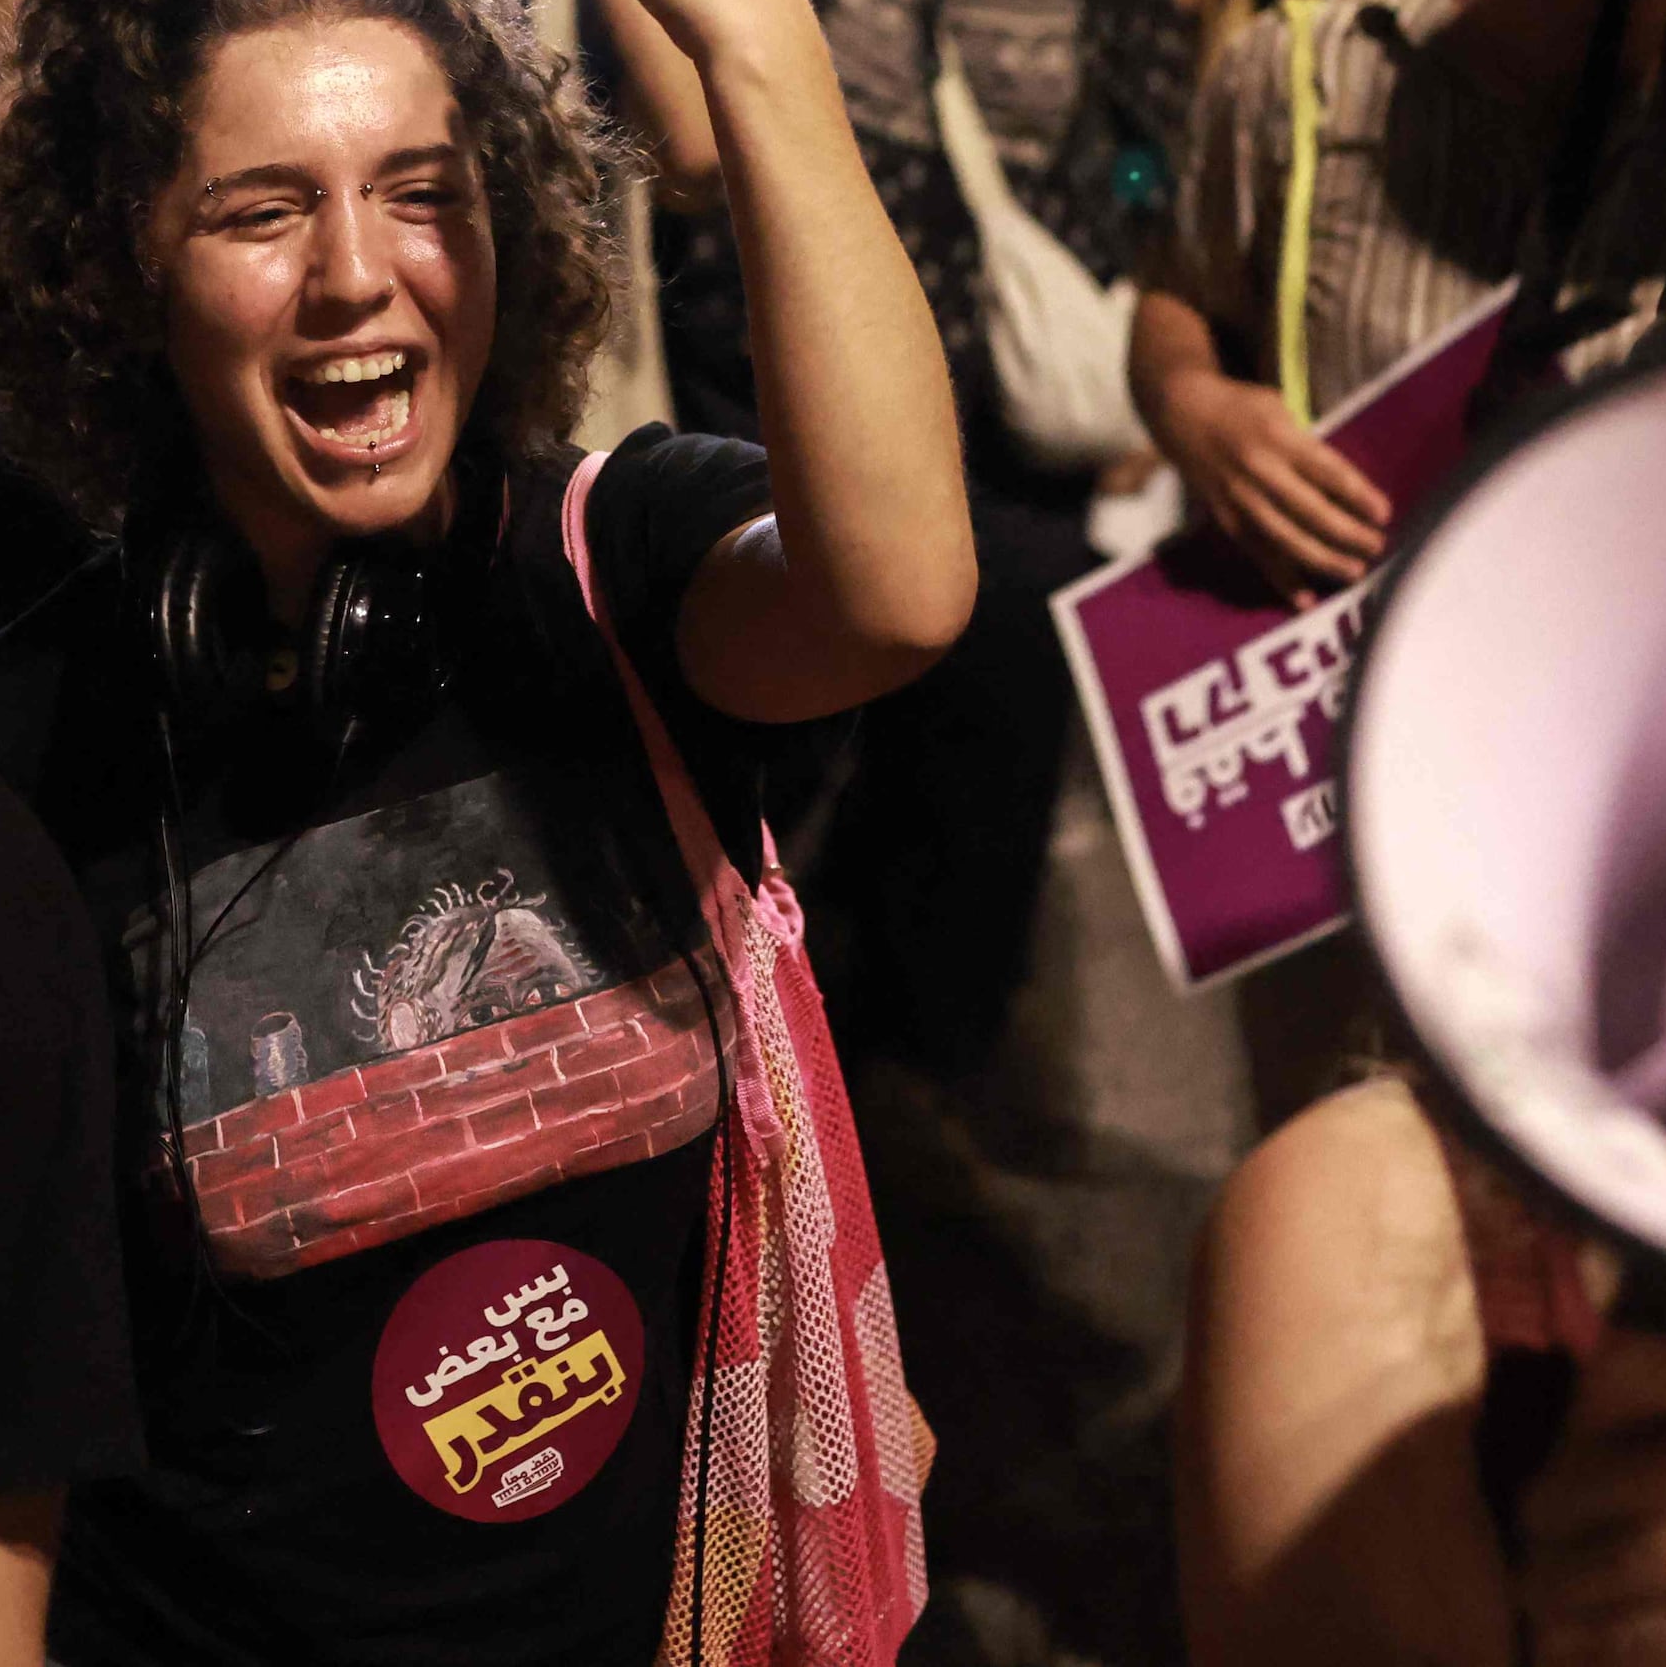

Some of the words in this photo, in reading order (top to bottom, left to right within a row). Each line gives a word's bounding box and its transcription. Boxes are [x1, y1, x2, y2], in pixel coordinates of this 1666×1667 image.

[483, 1264, 572, 1328] بس
[525, 1297, 589, 1352] مع
[404, 1330, 523, 1408] بعض
[447, 1352, 616, 1489] بنقدر
[495, 1483, 522, 1501] ביחד
[523, 1458, 559, 1485] עומדים
